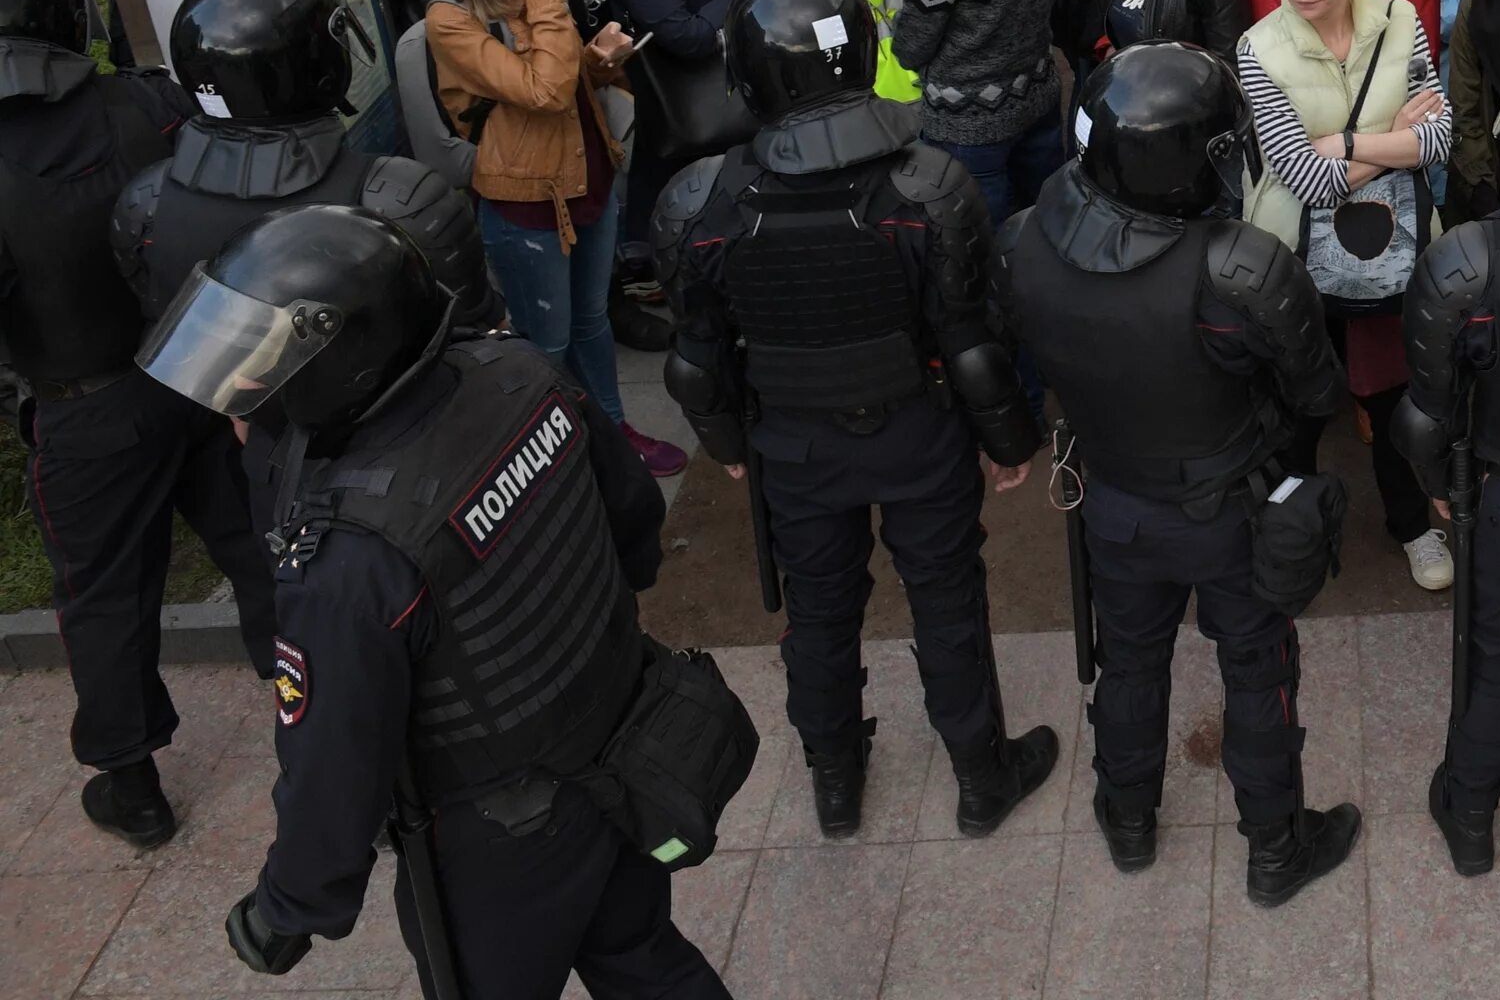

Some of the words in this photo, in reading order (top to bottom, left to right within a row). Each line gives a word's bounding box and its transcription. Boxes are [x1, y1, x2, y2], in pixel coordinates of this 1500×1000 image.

[823, 46, 842, 64] 37
[198, 83, 216, 95] 15
[464, 403, 575, 543] ПОЛИЦИЯ
